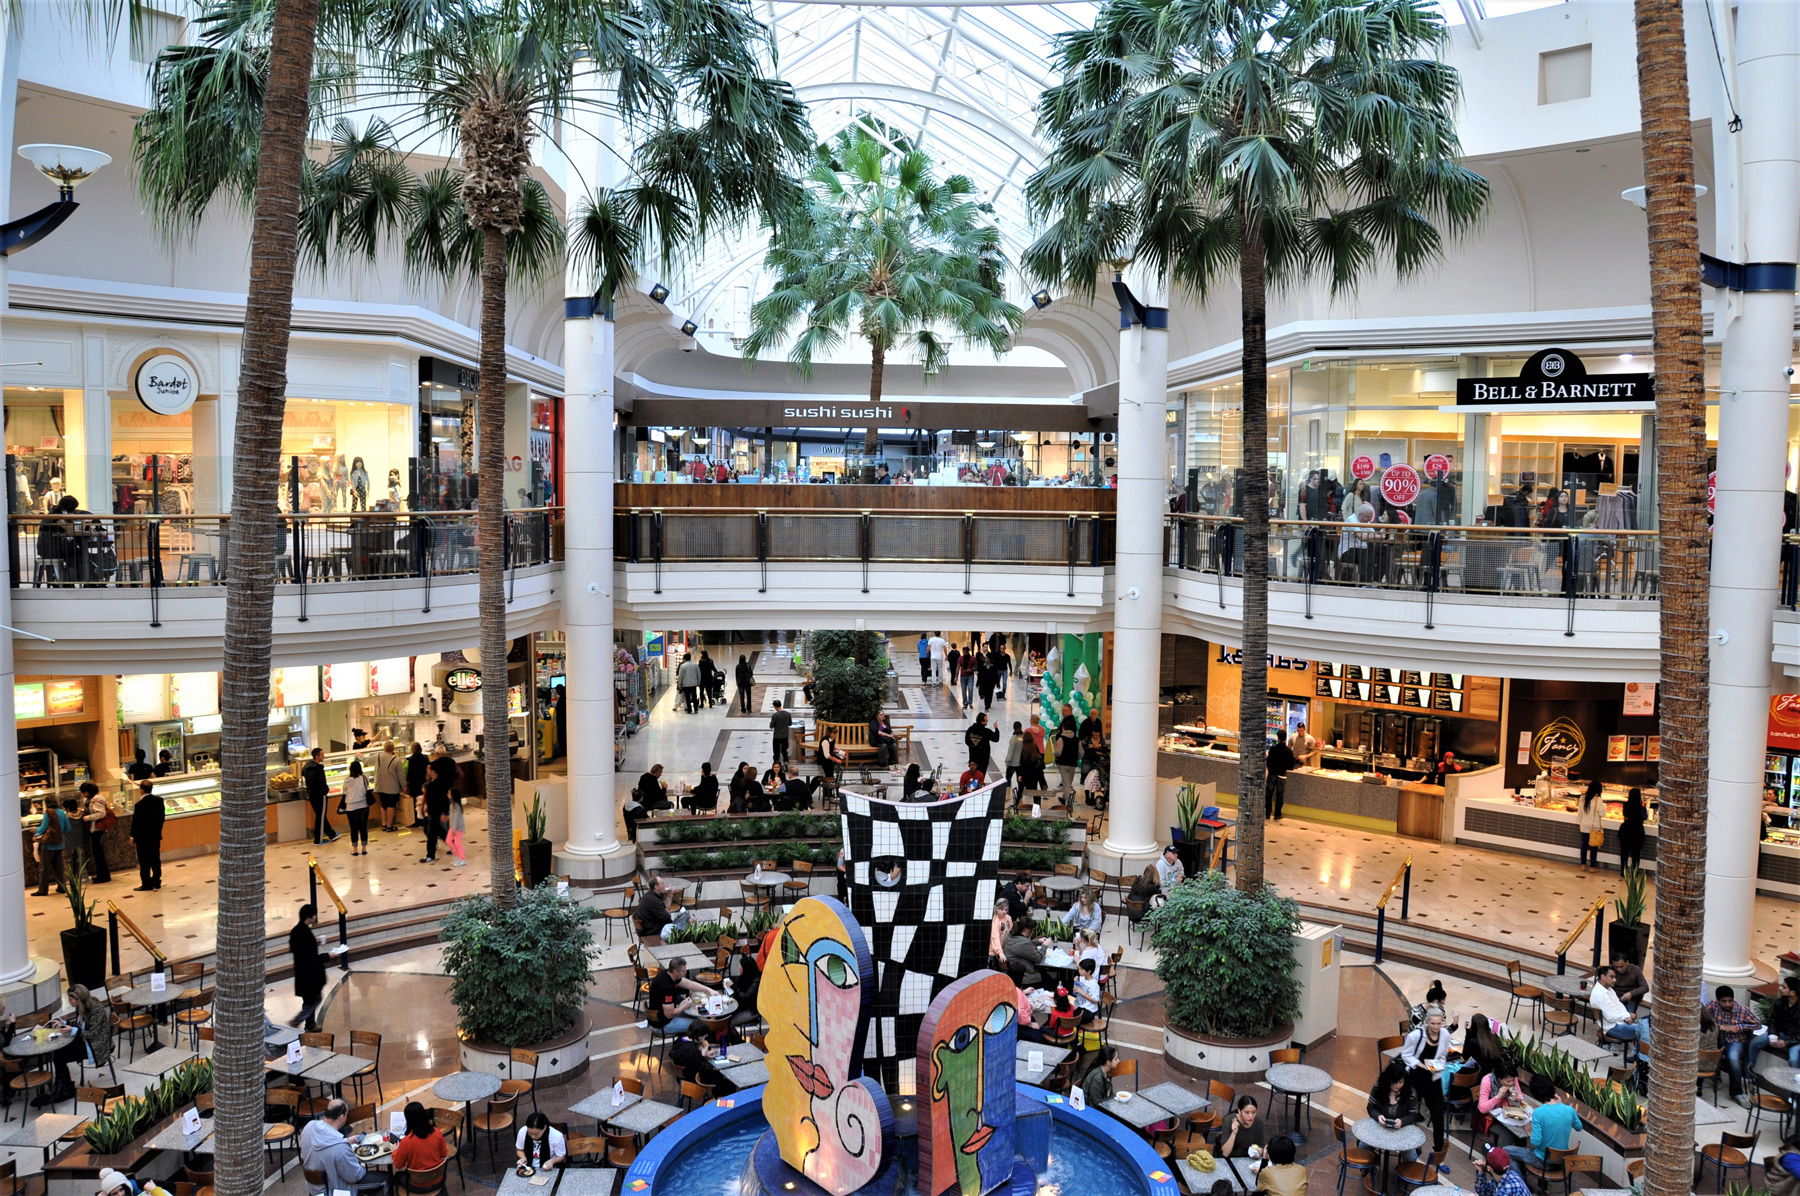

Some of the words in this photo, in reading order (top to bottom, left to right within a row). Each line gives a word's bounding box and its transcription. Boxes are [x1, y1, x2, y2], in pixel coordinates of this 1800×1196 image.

[149, 376, 188, 390] Bardot
[1473, 383, 1522, 400] BELL
[1525, 385, 1538, 399] &
[1541, 381, 1636, 399] BARNETT
[784, 406, 836, 418] sushi
[840, 407, 893, 419] sushi
[1385, 478, 1417, 493] 90%
